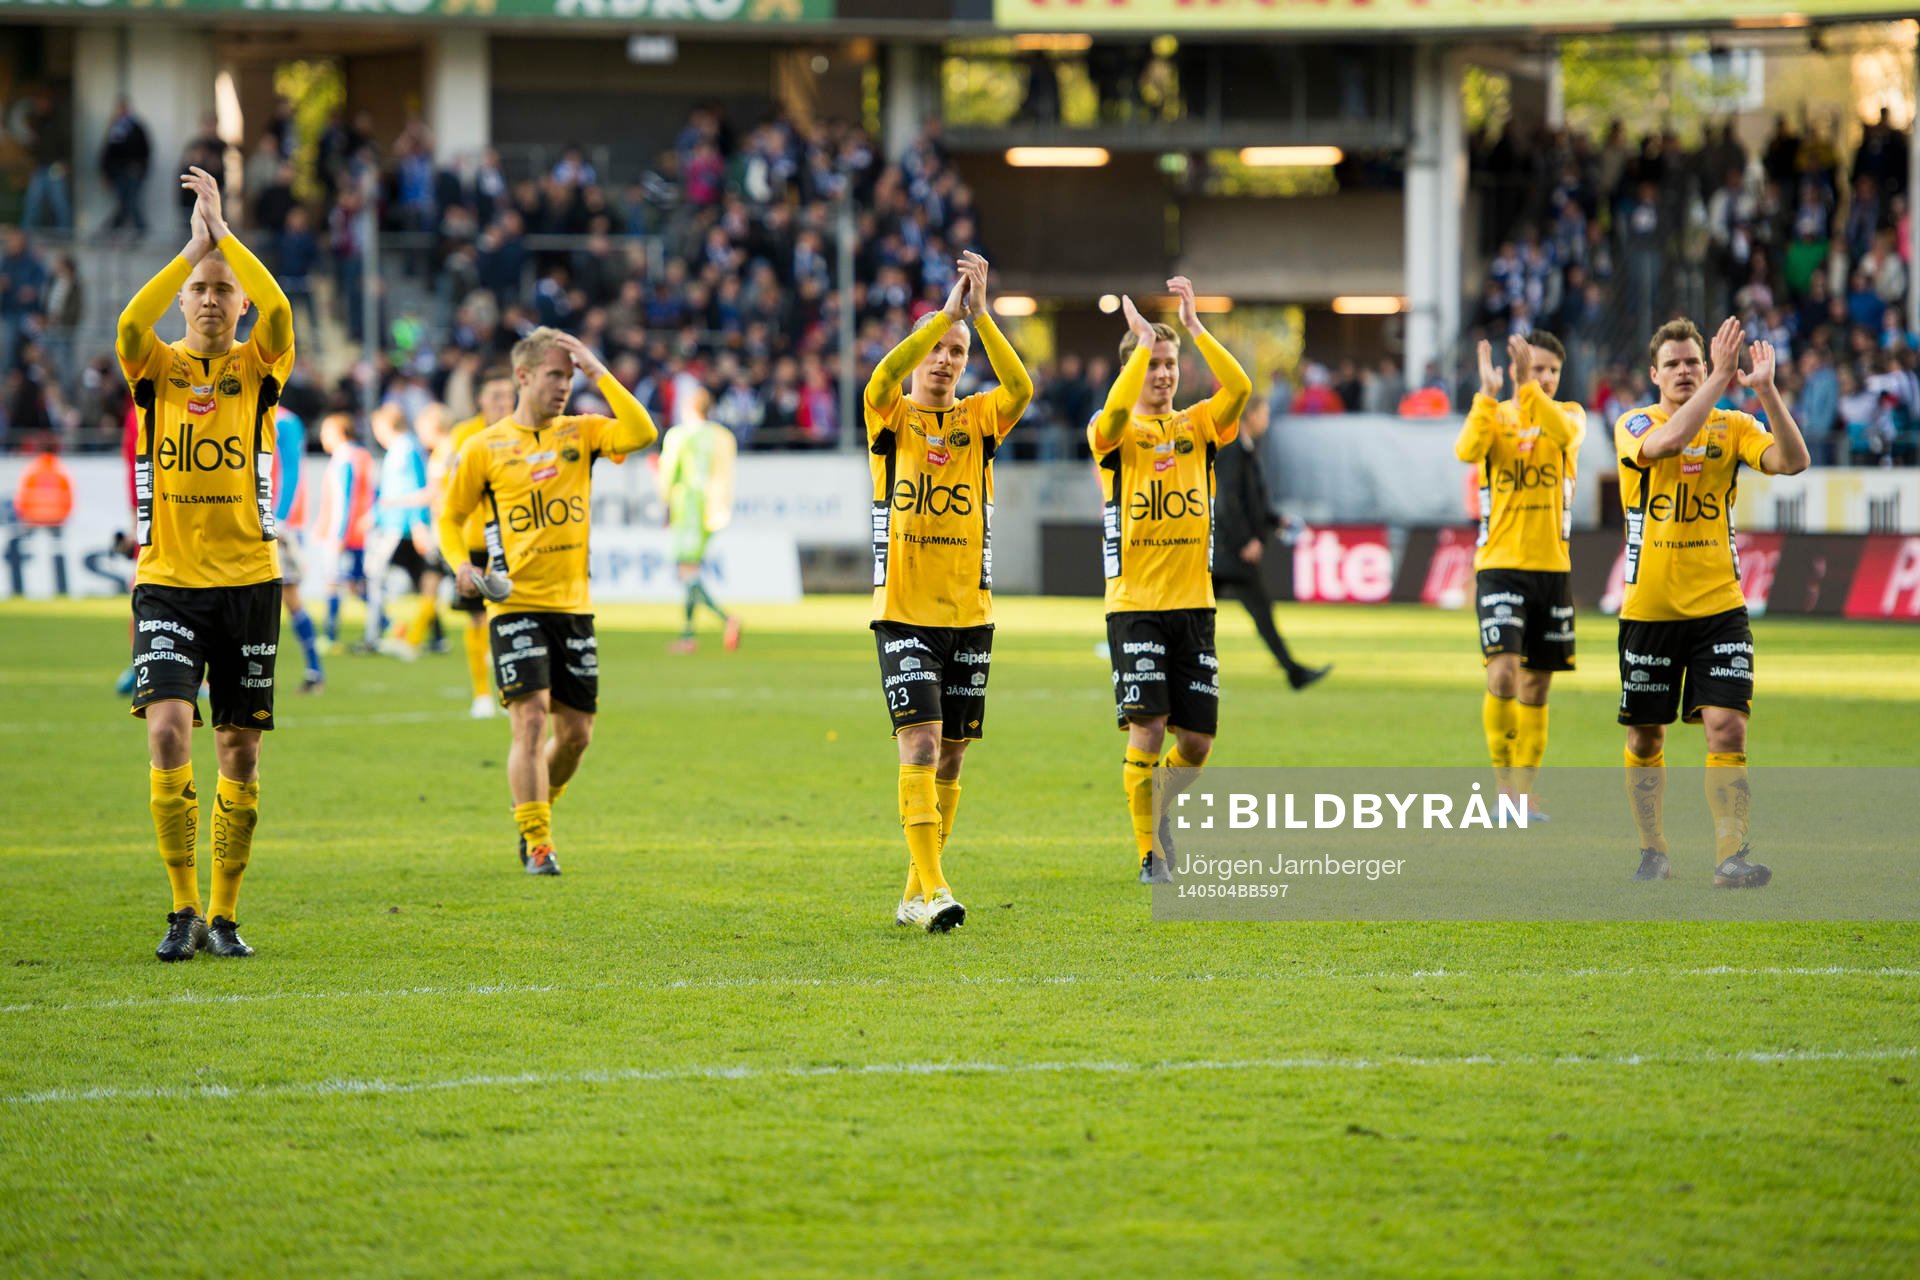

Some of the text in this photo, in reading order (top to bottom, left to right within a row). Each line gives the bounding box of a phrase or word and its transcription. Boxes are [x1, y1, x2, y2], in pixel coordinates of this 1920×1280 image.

[157, 423, 246, 472] ellos
[171, 494, 243, 504] TILLSAMMANS
[508, 489, 584, 533] ellos
[893, 472, 972, 515] ellos
[1130, 480, 1204, 520] ellos
[138, 620, 195, 640] tapet.se
[501, 663, 517, 684] 15
[888, 687, 909, 709] 23
[213, 813, 230, 868] Ecotec
